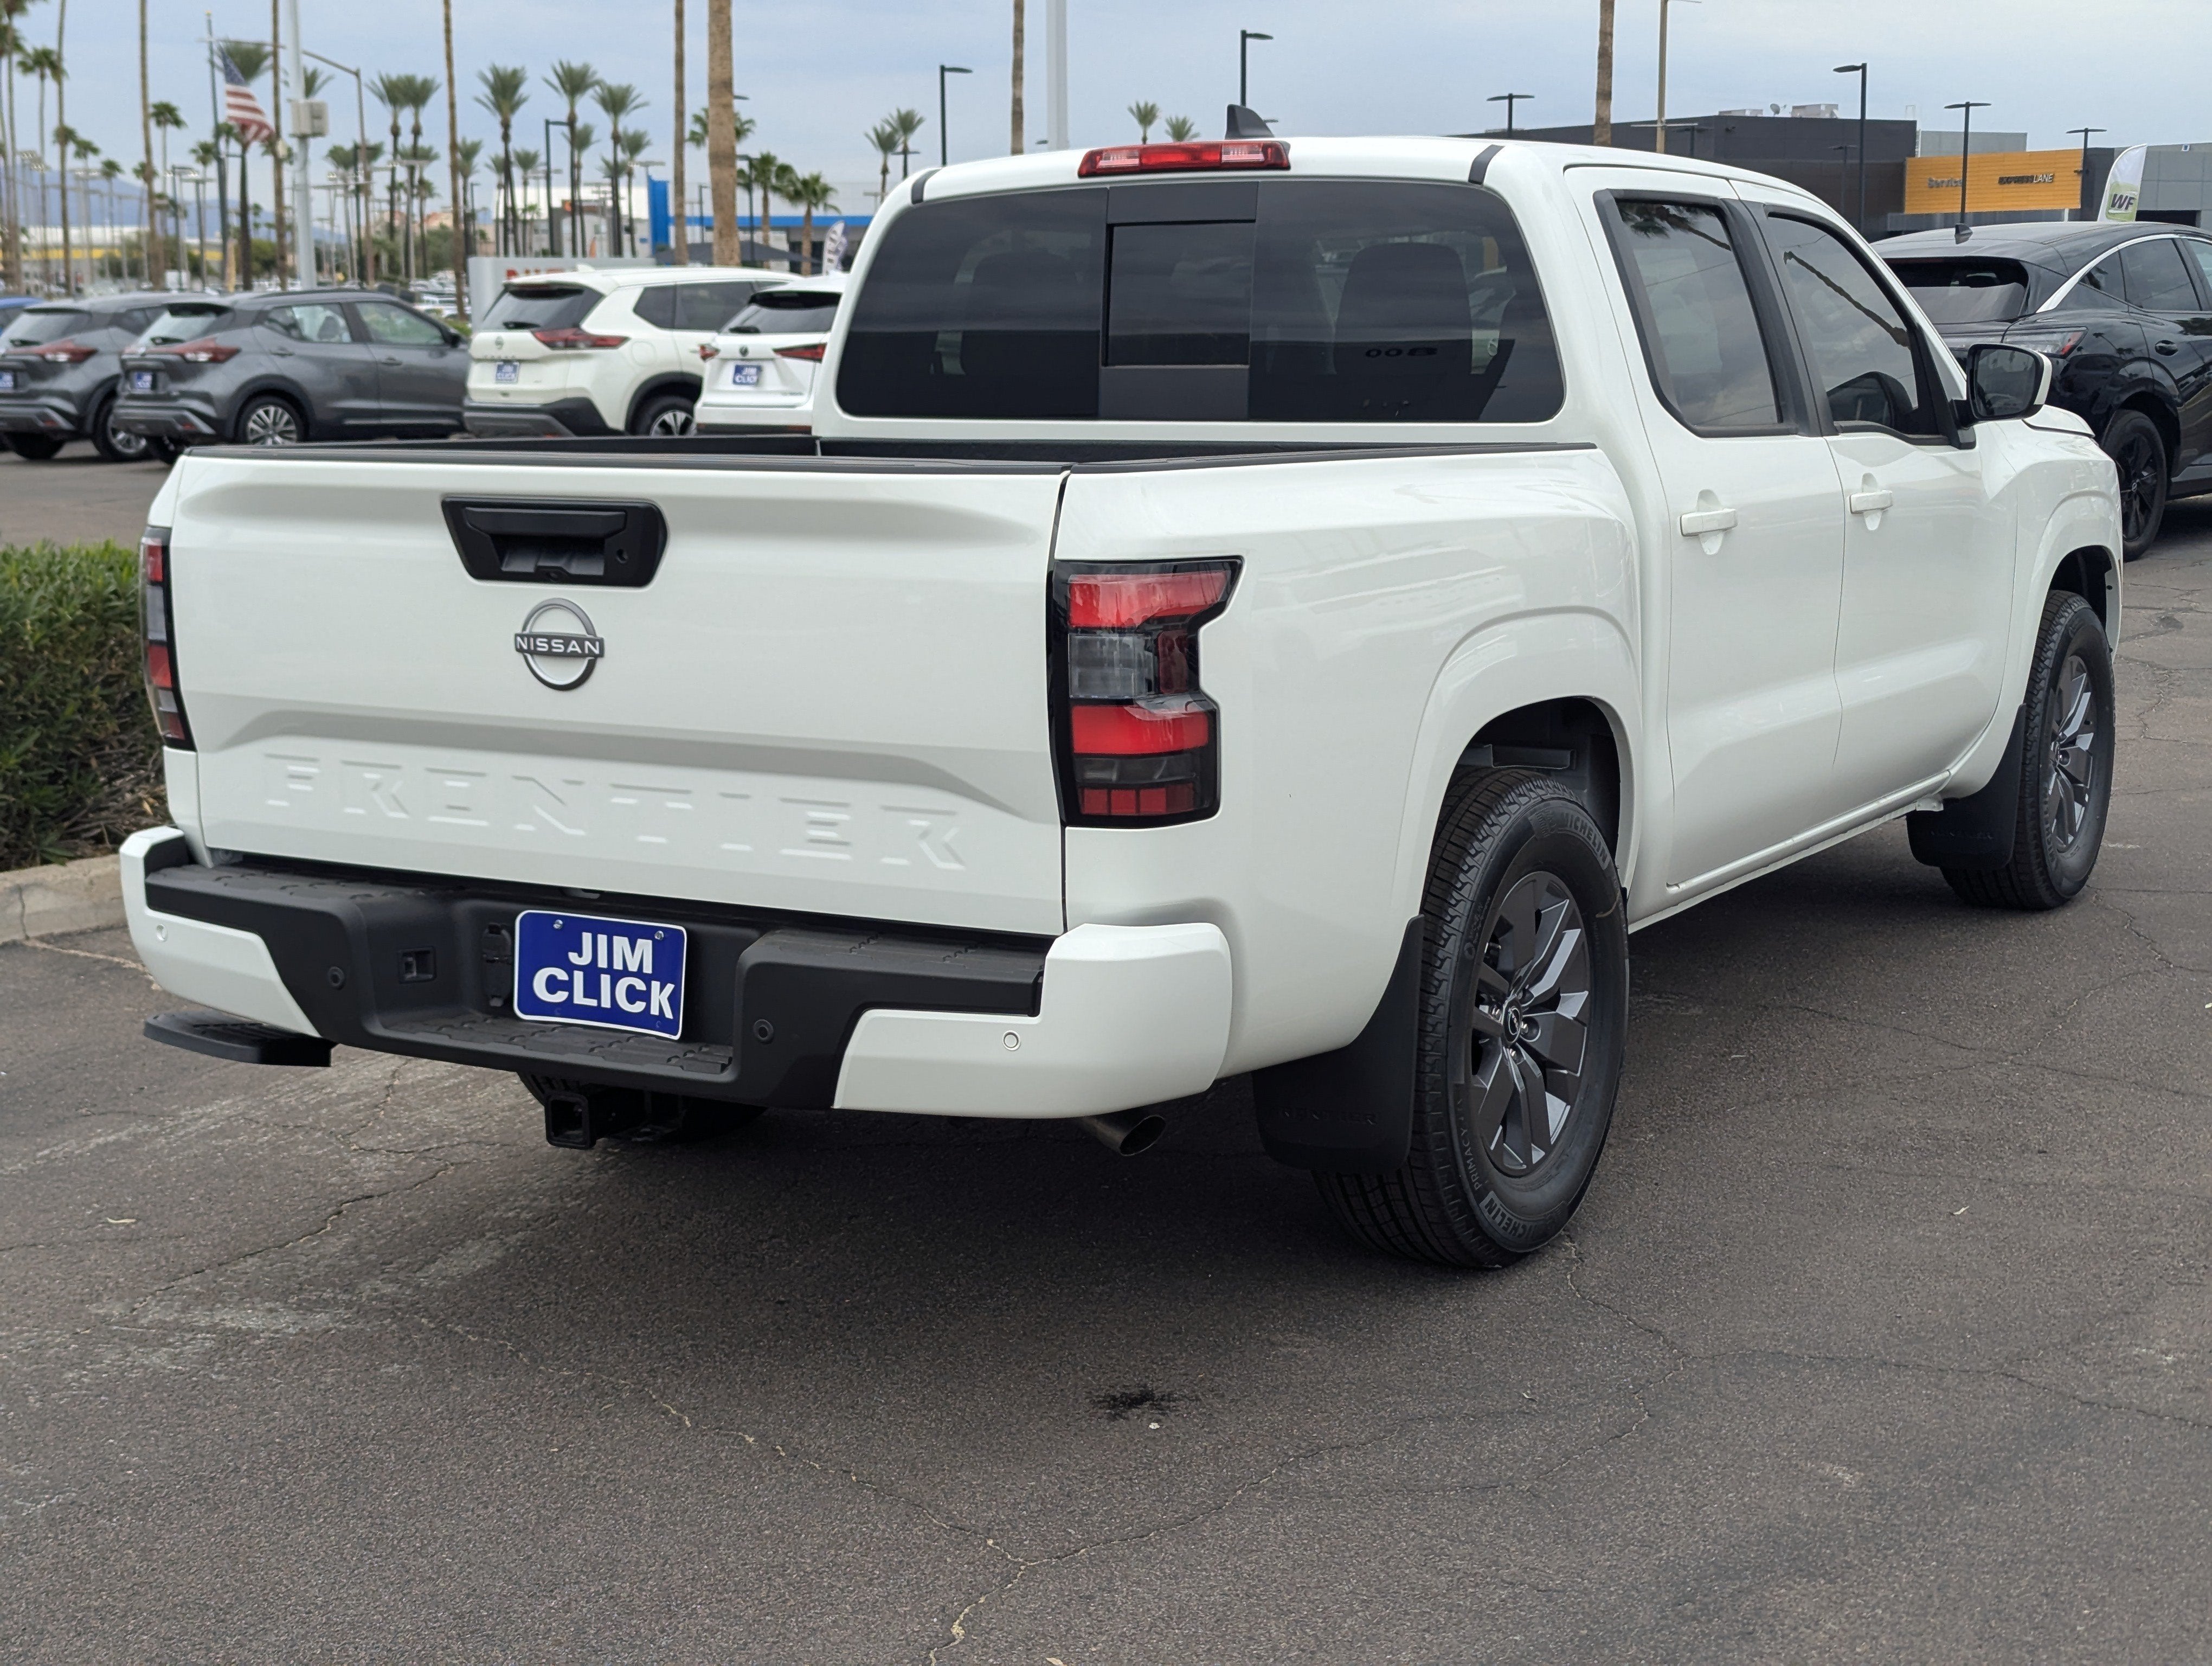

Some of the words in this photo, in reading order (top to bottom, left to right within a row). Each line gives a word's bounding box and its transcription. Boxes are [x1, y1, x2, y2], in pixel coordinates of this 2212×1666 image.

[2111, 193, 2136, 210] WF
[516, 636, 600, 655] NISSAN
[263, 753, 966, 870] FRONTIER
[568, 932, 653, 974] JIM
[532, 967, 676, 1020] CLICK
[1461, 1127, 1483, 1191] PRIMACY
